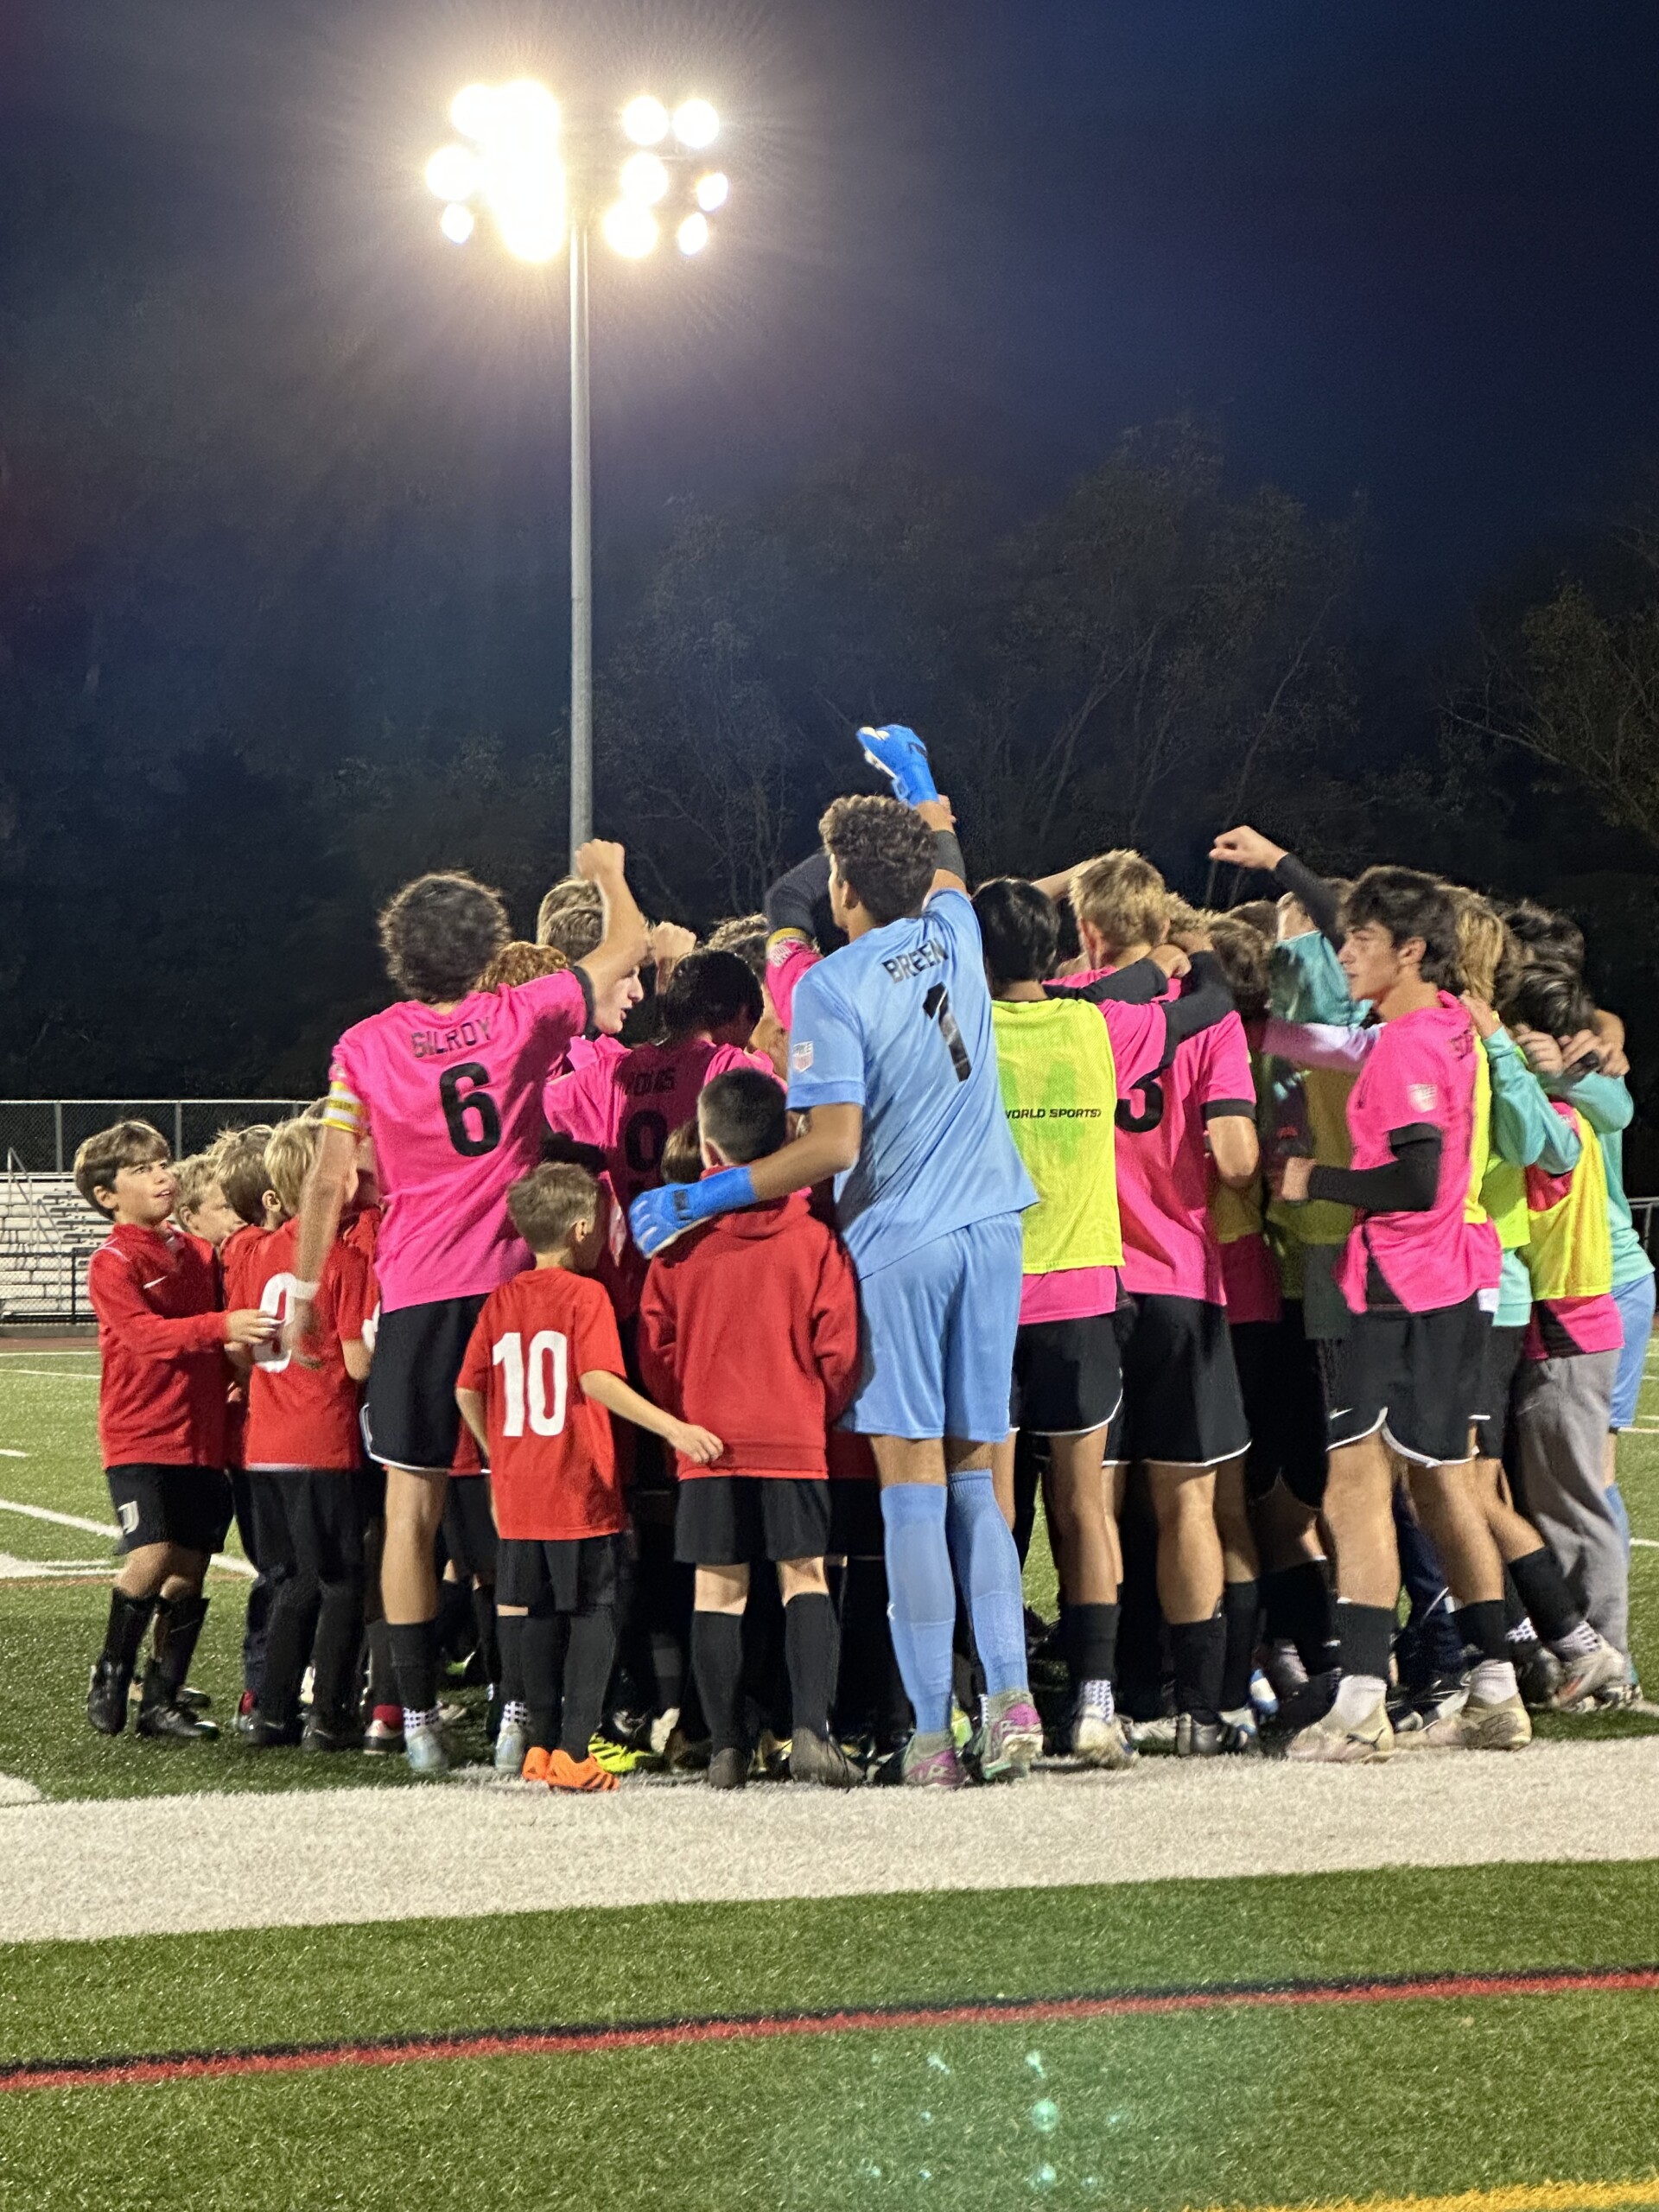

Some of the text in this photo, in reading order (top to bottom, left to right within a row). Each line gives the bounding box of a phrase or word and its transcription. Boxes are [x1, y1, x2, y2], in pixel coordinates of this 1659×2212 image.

[881, 938, 949, 983] BREEN
[411, 1017, 491, 1058] GILROY
[922, 982, 972, 1082] 1
[439, 1061, 501, 1157] 6
[492, 1330, 569, 1437] 10
